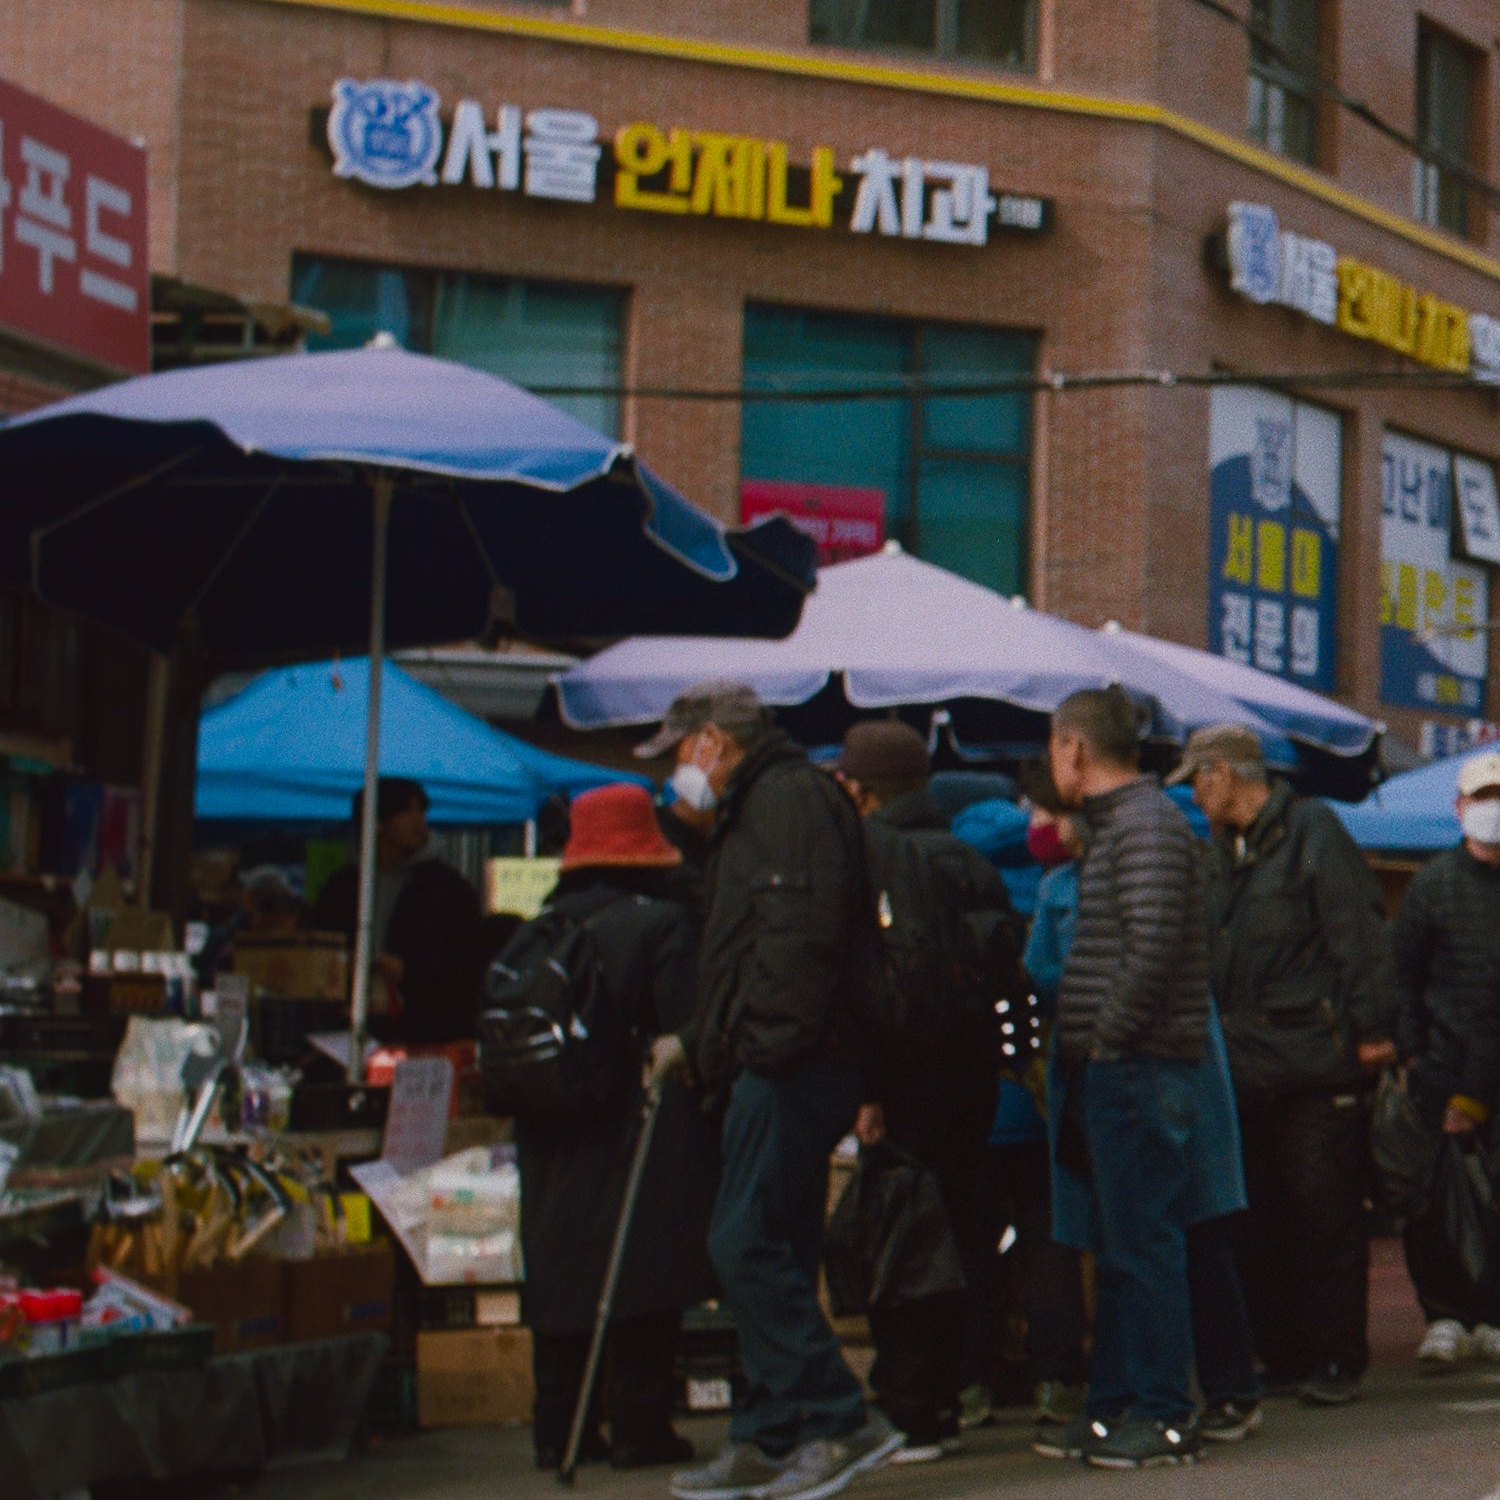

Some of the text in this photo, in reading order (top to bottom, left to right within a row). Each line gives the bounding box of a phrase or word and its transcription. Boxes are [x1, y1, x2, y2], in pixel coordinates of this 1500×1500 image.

[0, 118, 138, 313] 푸드
[441, 98, 997, 247] 서울 언제나 치과
[1221, 510, 1322, 598] 서울대
[1221, 590, 1320, 677] 전문의
